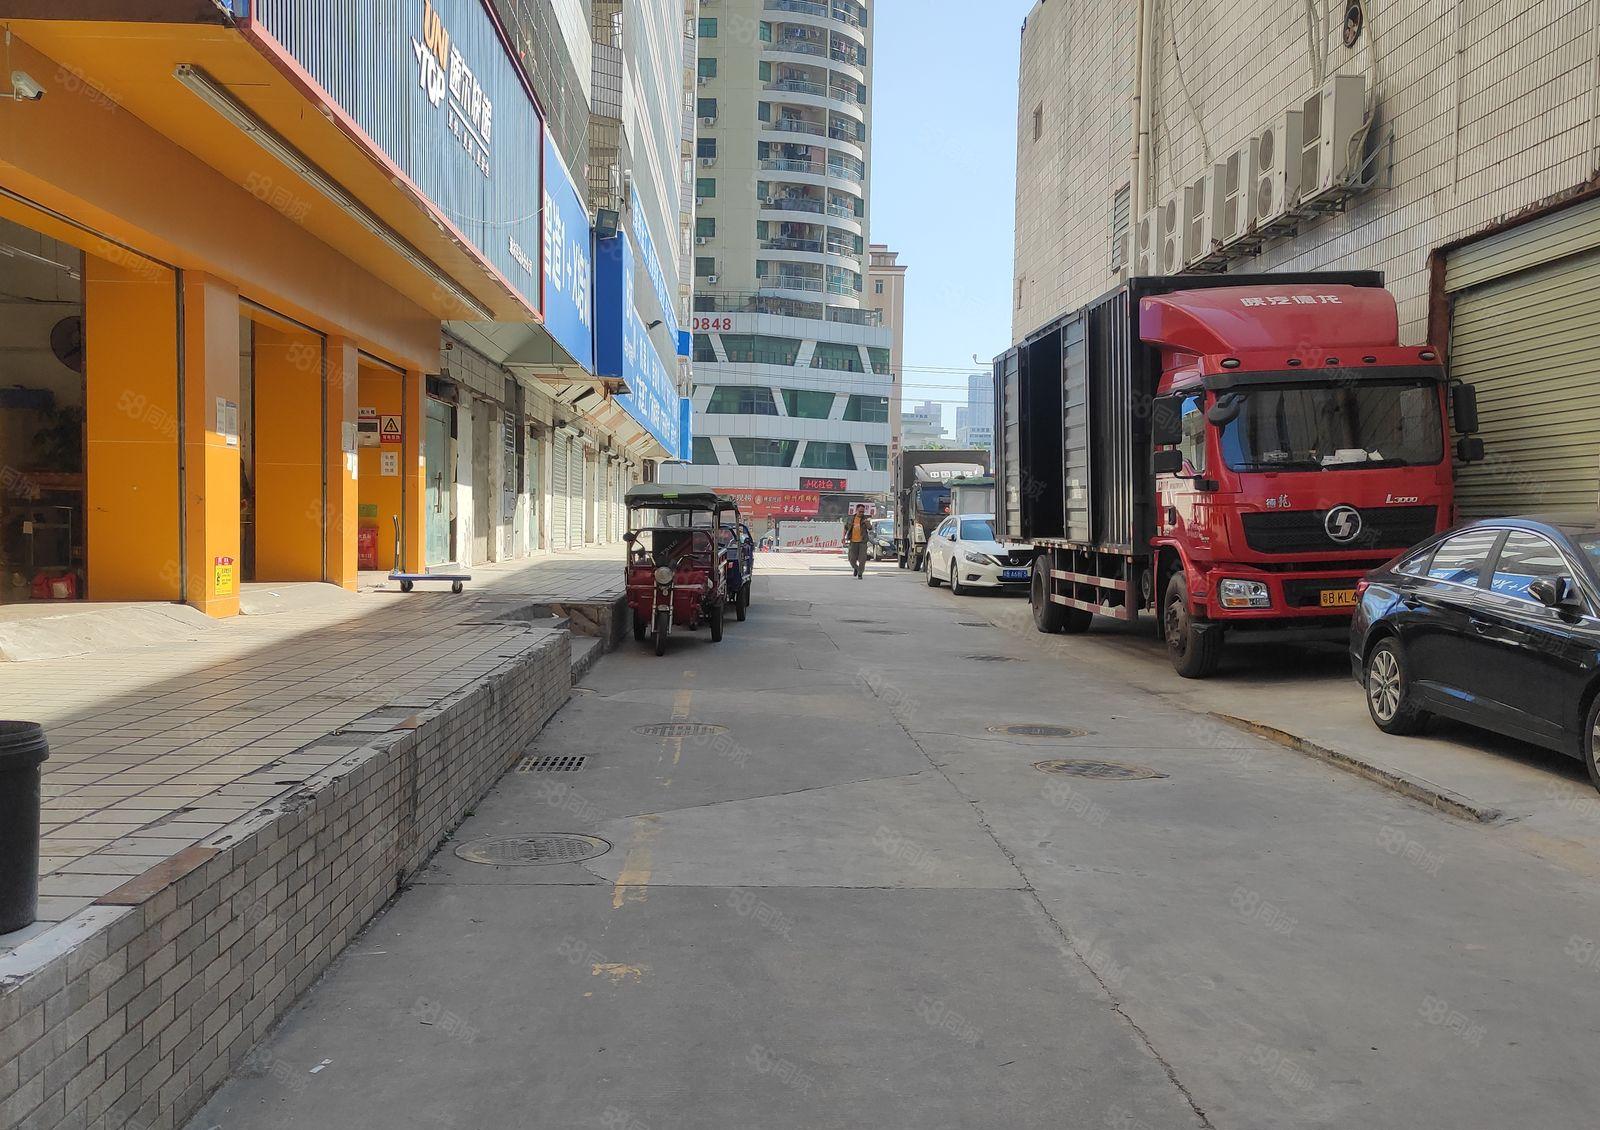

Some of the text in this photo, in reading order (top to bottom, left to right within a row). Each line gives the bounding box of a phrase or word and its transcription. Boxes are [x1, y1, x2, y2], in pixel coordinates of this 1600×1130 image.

[423, 0, 449, 71] UNI
[411, 36, 446, 108] TOP
[1240, 294, 1343, 307] 陕汽德龙
[1385, 493, 1418, 504] L3000
